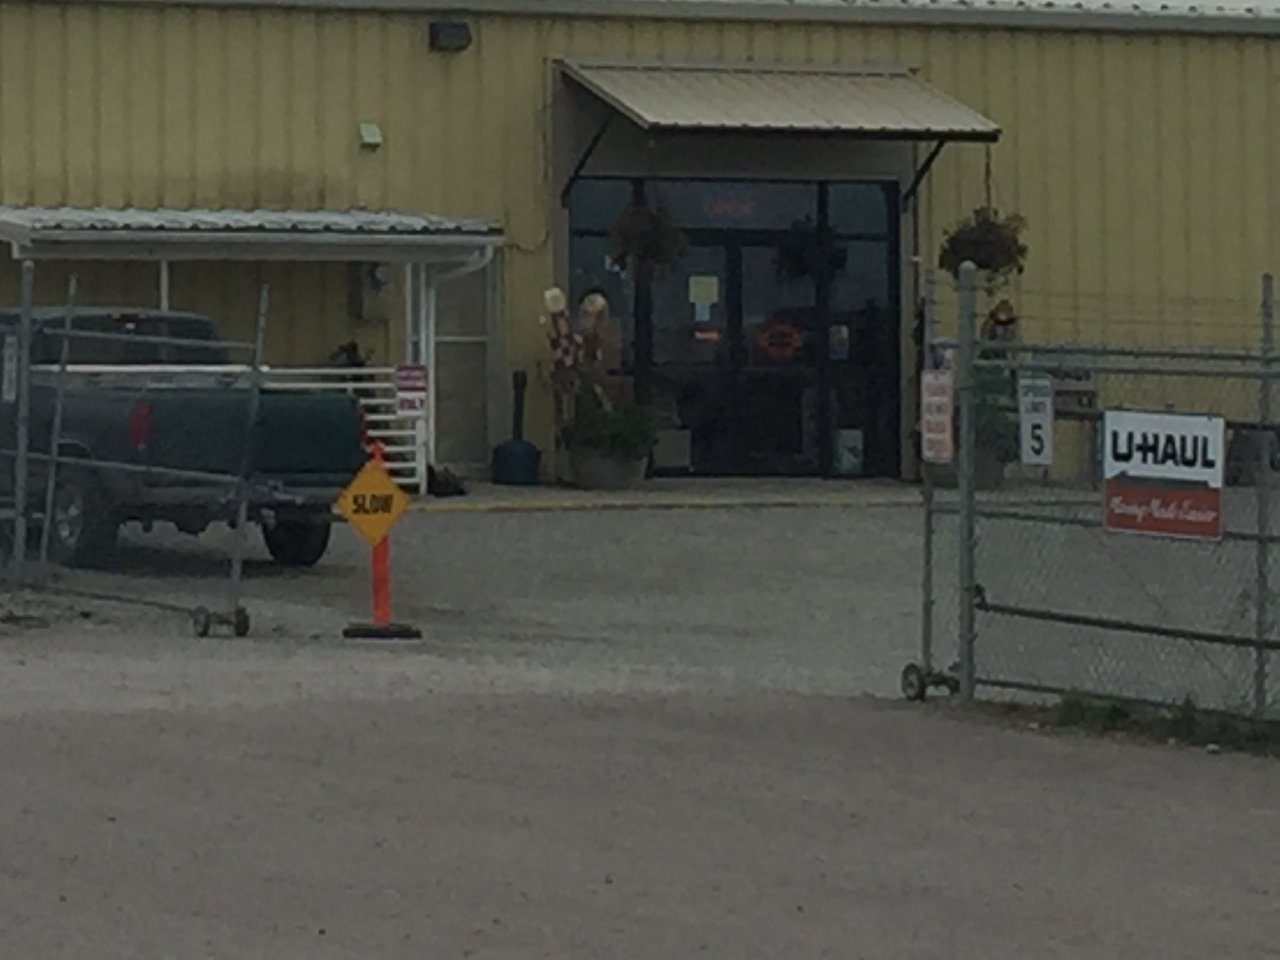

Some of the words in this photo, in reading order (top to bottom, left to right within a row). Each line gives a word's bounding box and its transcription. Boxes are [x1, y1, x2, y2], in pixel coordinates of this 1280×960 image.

[1030, 424, 1045, 456] 5
[1111, 430, 1216, 469] U-HAUL
[352, 494, 393, 514] SLOW
